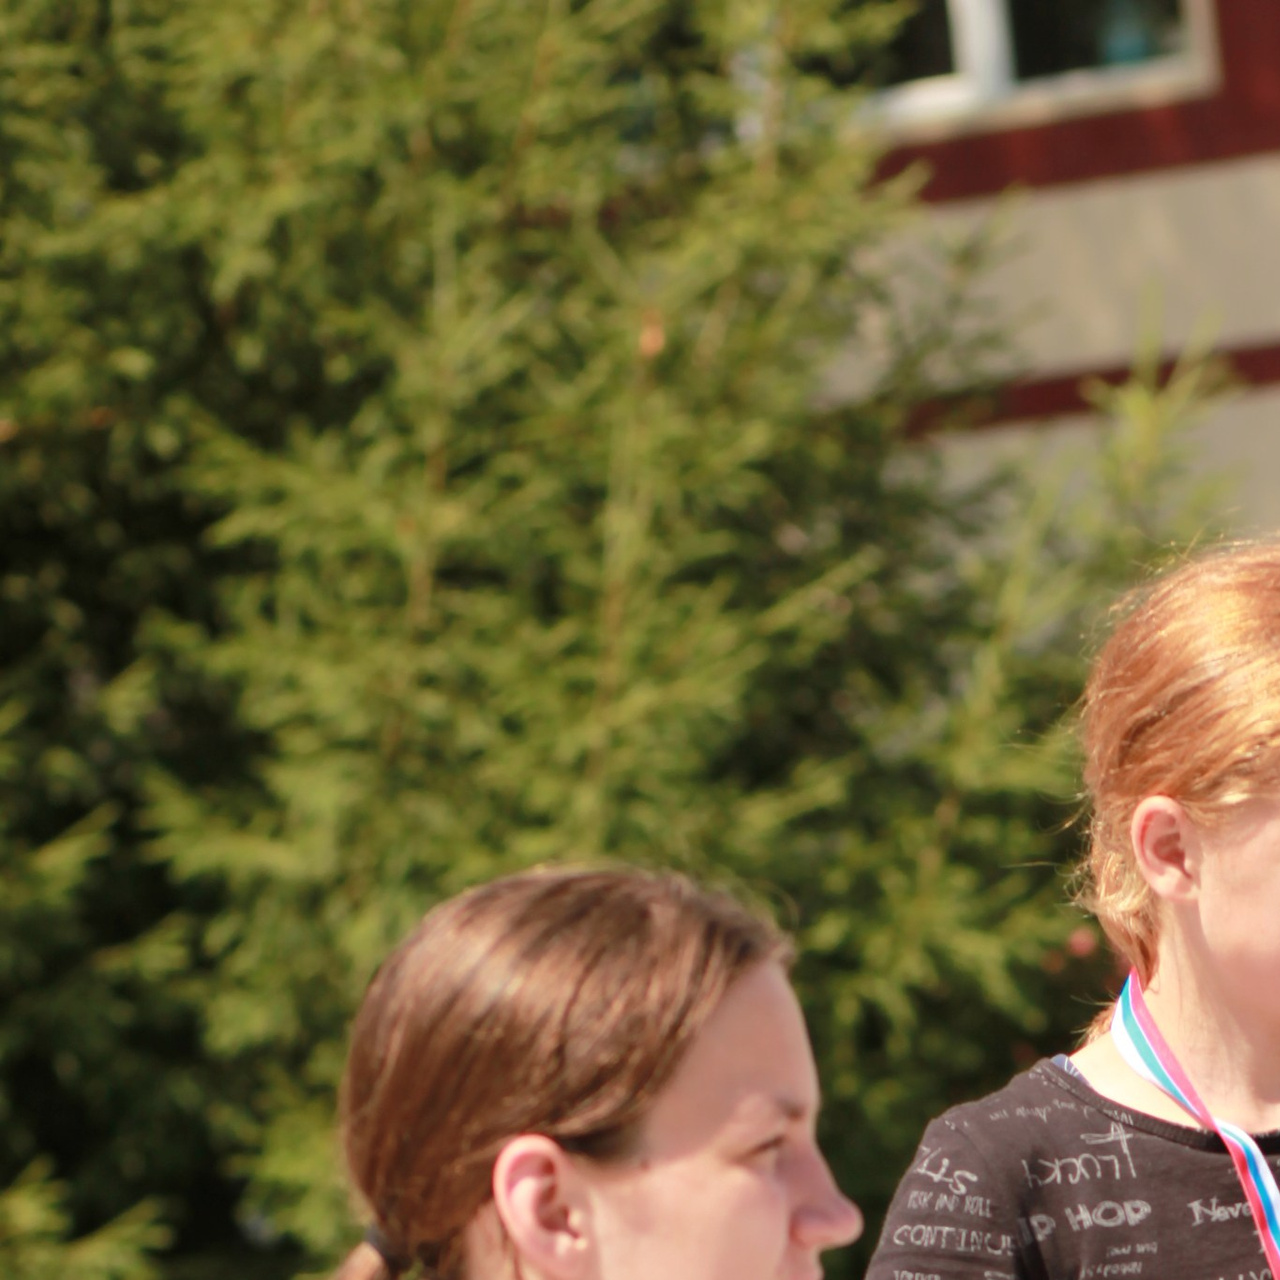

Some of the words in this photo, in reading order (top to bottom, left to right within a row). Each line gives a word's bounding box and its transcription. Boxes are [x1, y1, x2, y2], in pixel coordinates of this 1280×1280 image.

[1021, 1153, 1120, 1187] LUCKY
[1064, 1199, 1152, 1233] HOP
[1187, 1196, 1253, 1226] Neve
